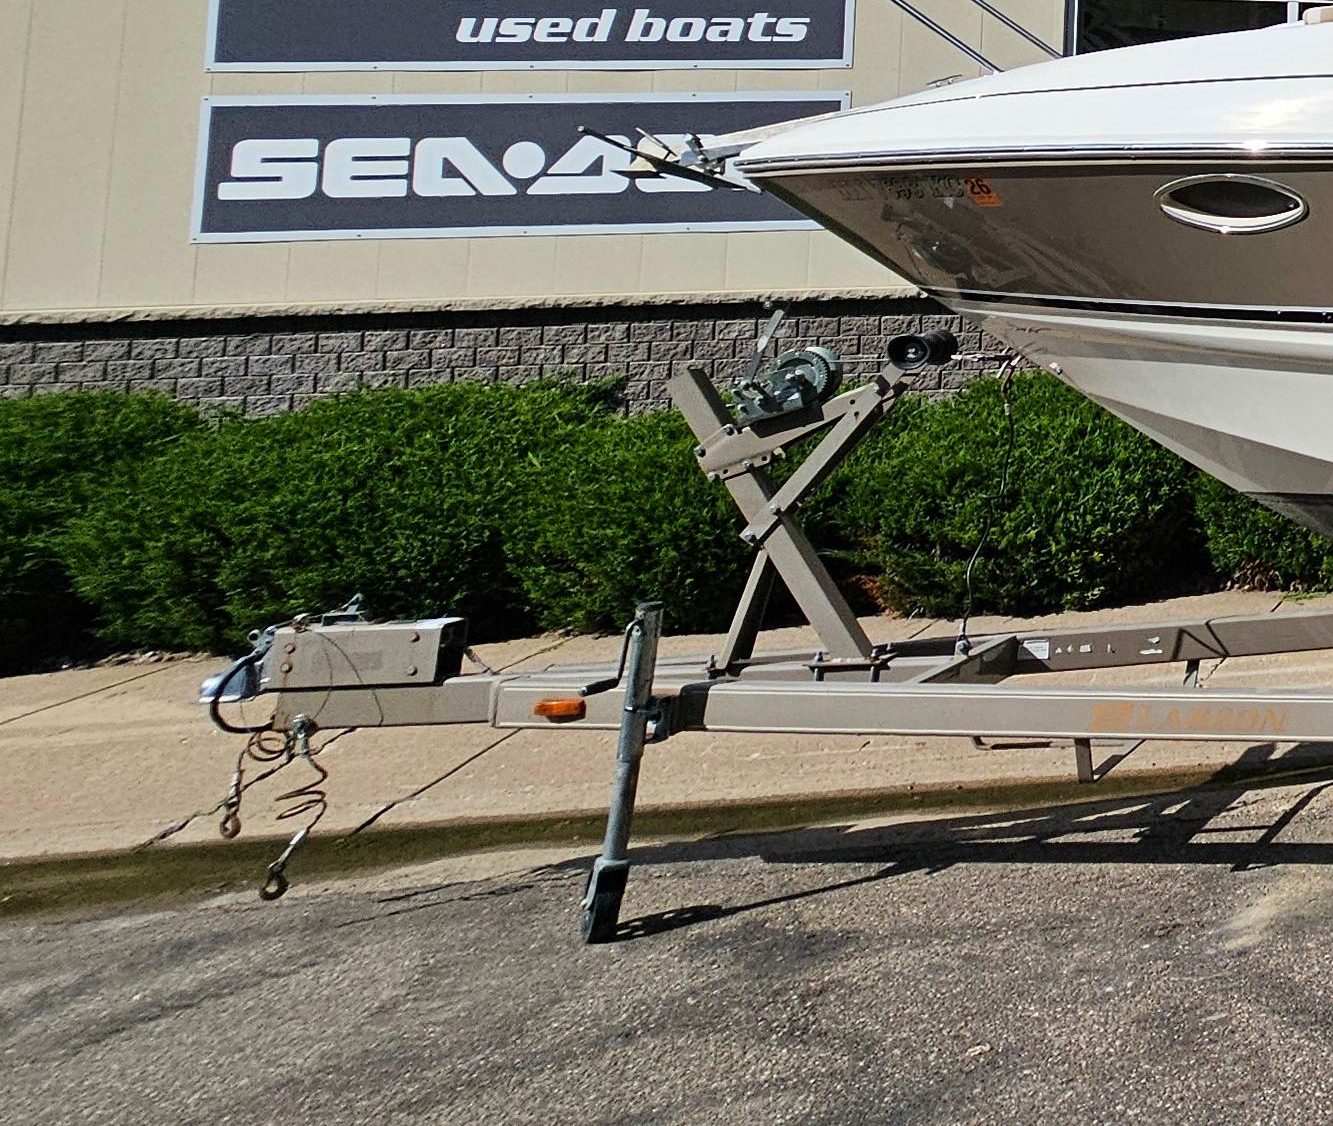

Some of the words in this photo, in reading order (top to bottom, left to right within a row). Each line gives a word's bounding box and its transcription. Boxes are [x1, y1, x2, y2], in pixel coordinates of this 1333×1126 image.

[454, 8, 619, 43] used
[624, 8, 811, 44] boats
[964, 177, 992, 196] 26
